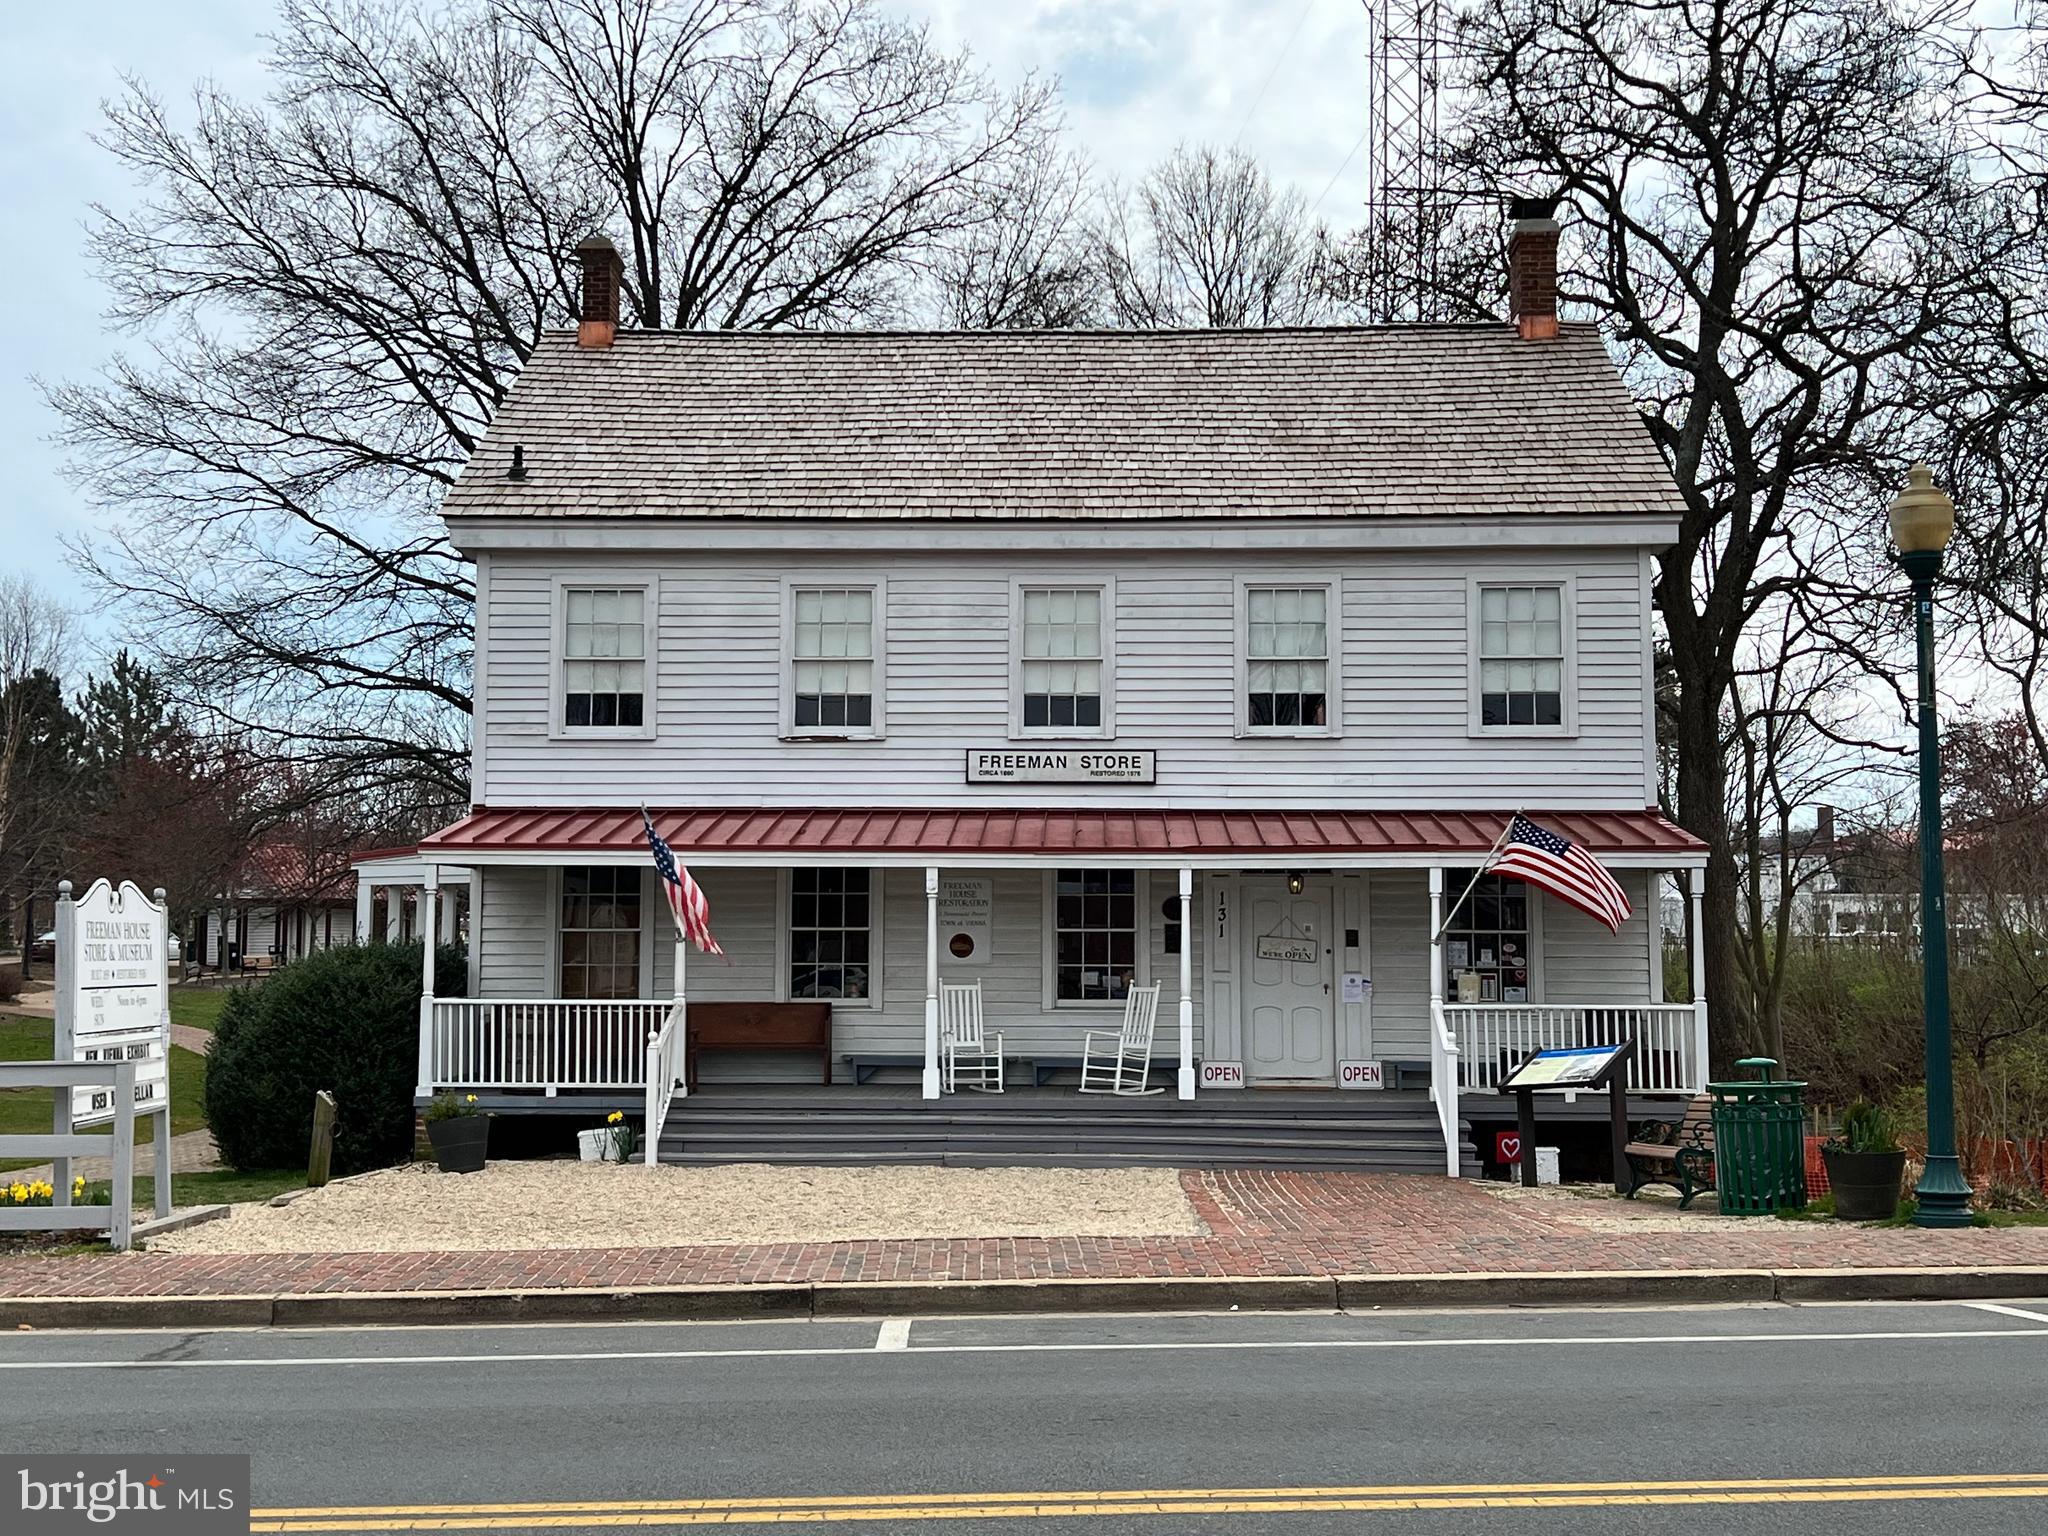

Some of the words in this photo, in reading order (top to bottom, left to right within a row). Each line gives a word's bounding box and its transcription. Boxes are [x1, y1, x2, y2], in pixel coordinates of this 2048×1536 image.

[979, 755, 1067, 769] FREEMAN
[1080, 755, 1142, 769] STORE
[943, 882, 983, 890] FREEMAN
[949, 890, 977, 898] HOUSE
[938, 899, 989, 907] RESTORATION
[1218, 891, 1227, 938] 131
[85, 921, 121, 939] FREEMAN
[124, 922, 151, 940] HOUSE
[84, 943, 108, 962] STORE
[109, 943, 116, 961] &
[118, 943, 153, 961] MUSEUM
[1284, 950, 1312, 960] OPEN
[86, 1050, 98, 1060] NEW
[127, 1043, 150, 1060] EXHIBIT
[1204, 1067, 1241, 1081] OPEN
[1343, 1066, 1380, 1081] OPEN
[92, 1092, 107, 1110] USED
[134, 1083, 153, 1102] ELLAR
